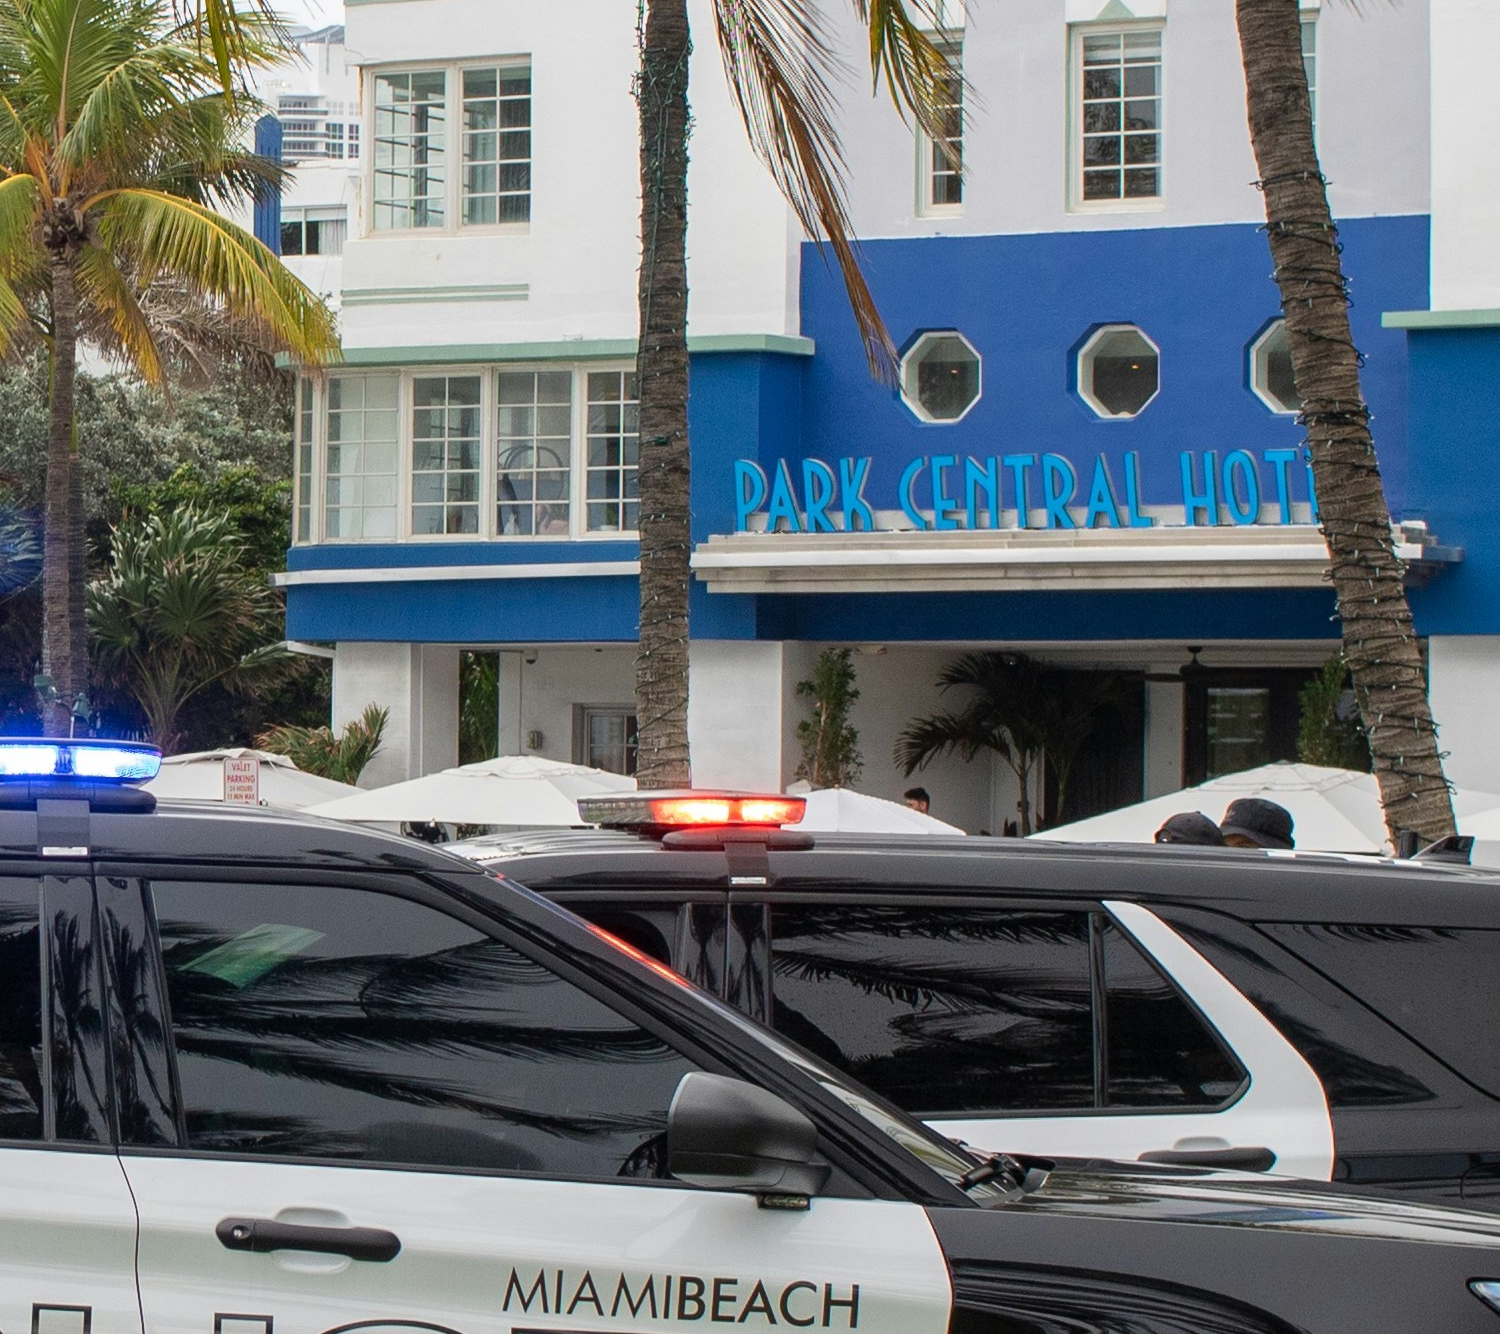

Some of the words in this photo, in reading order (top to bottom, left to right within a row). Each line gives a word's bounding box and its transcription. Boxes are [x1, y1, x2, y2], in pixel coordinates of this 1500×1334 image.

[735, 457, 873, 532] PARK
[897, 451, 1155, 531] CENTRAL
[1180, 449, 1319, 526] HOT
[231, 762, 251, 771] VALET
[227, 774, 256, 783] PARKING
